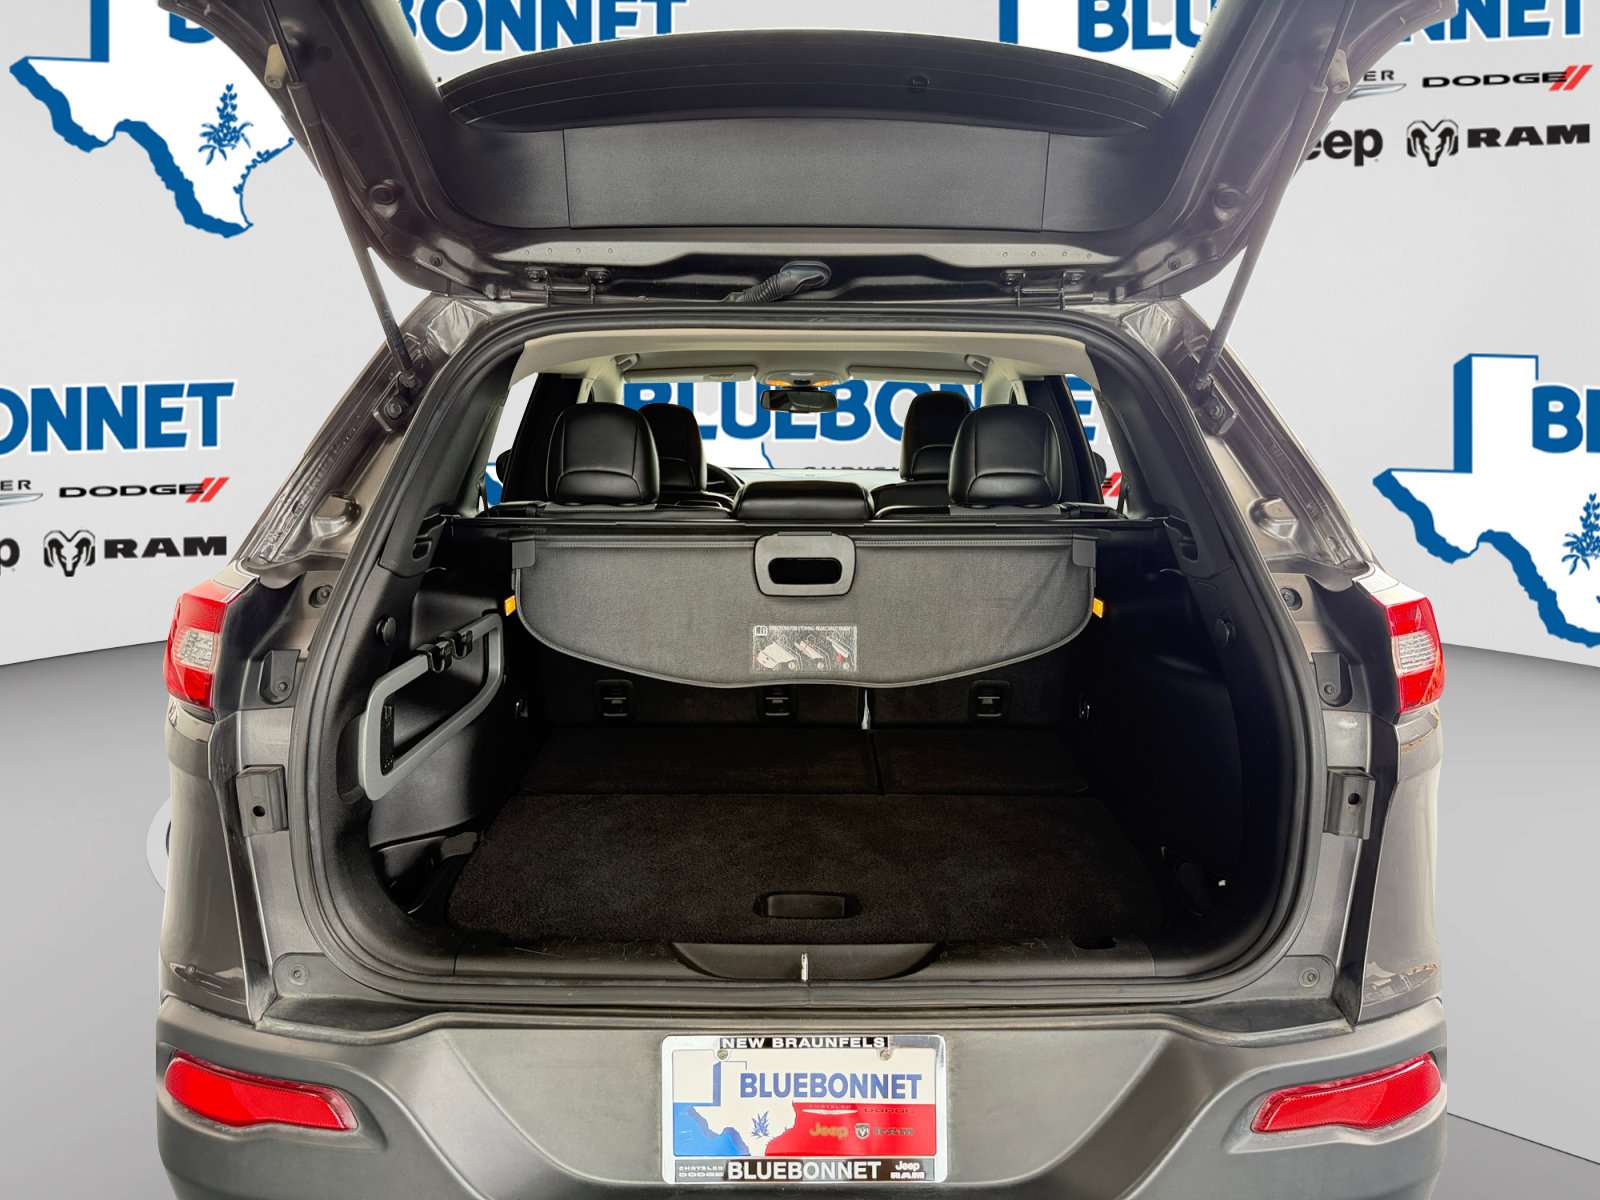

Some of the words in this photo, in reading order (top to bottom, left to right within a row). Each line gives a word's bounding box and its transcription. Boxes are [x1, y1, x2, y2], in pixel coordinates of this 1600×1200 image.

[1422, 71, 1567, 88] DODGE
[1467, 124, 1591, 148] RAM
[1305, 128, 1383, 167] ep
[59, 483, 204, 498] DODGE
[104, 536, 227, 559] RAM
[722, 1037, 765, 1049] NEW
[772, 1037, 885, 1049] BRAUNFELS
[740, 1072, 922, 1100] BLUEBONNET
[809, 1122, 849, 1140] Jeep
[728, 1161, 882, 1180] BLUEBONNET
[890, 1171, 925, 1179] RAM
[895, 1160, 920, 1172] Jeep
